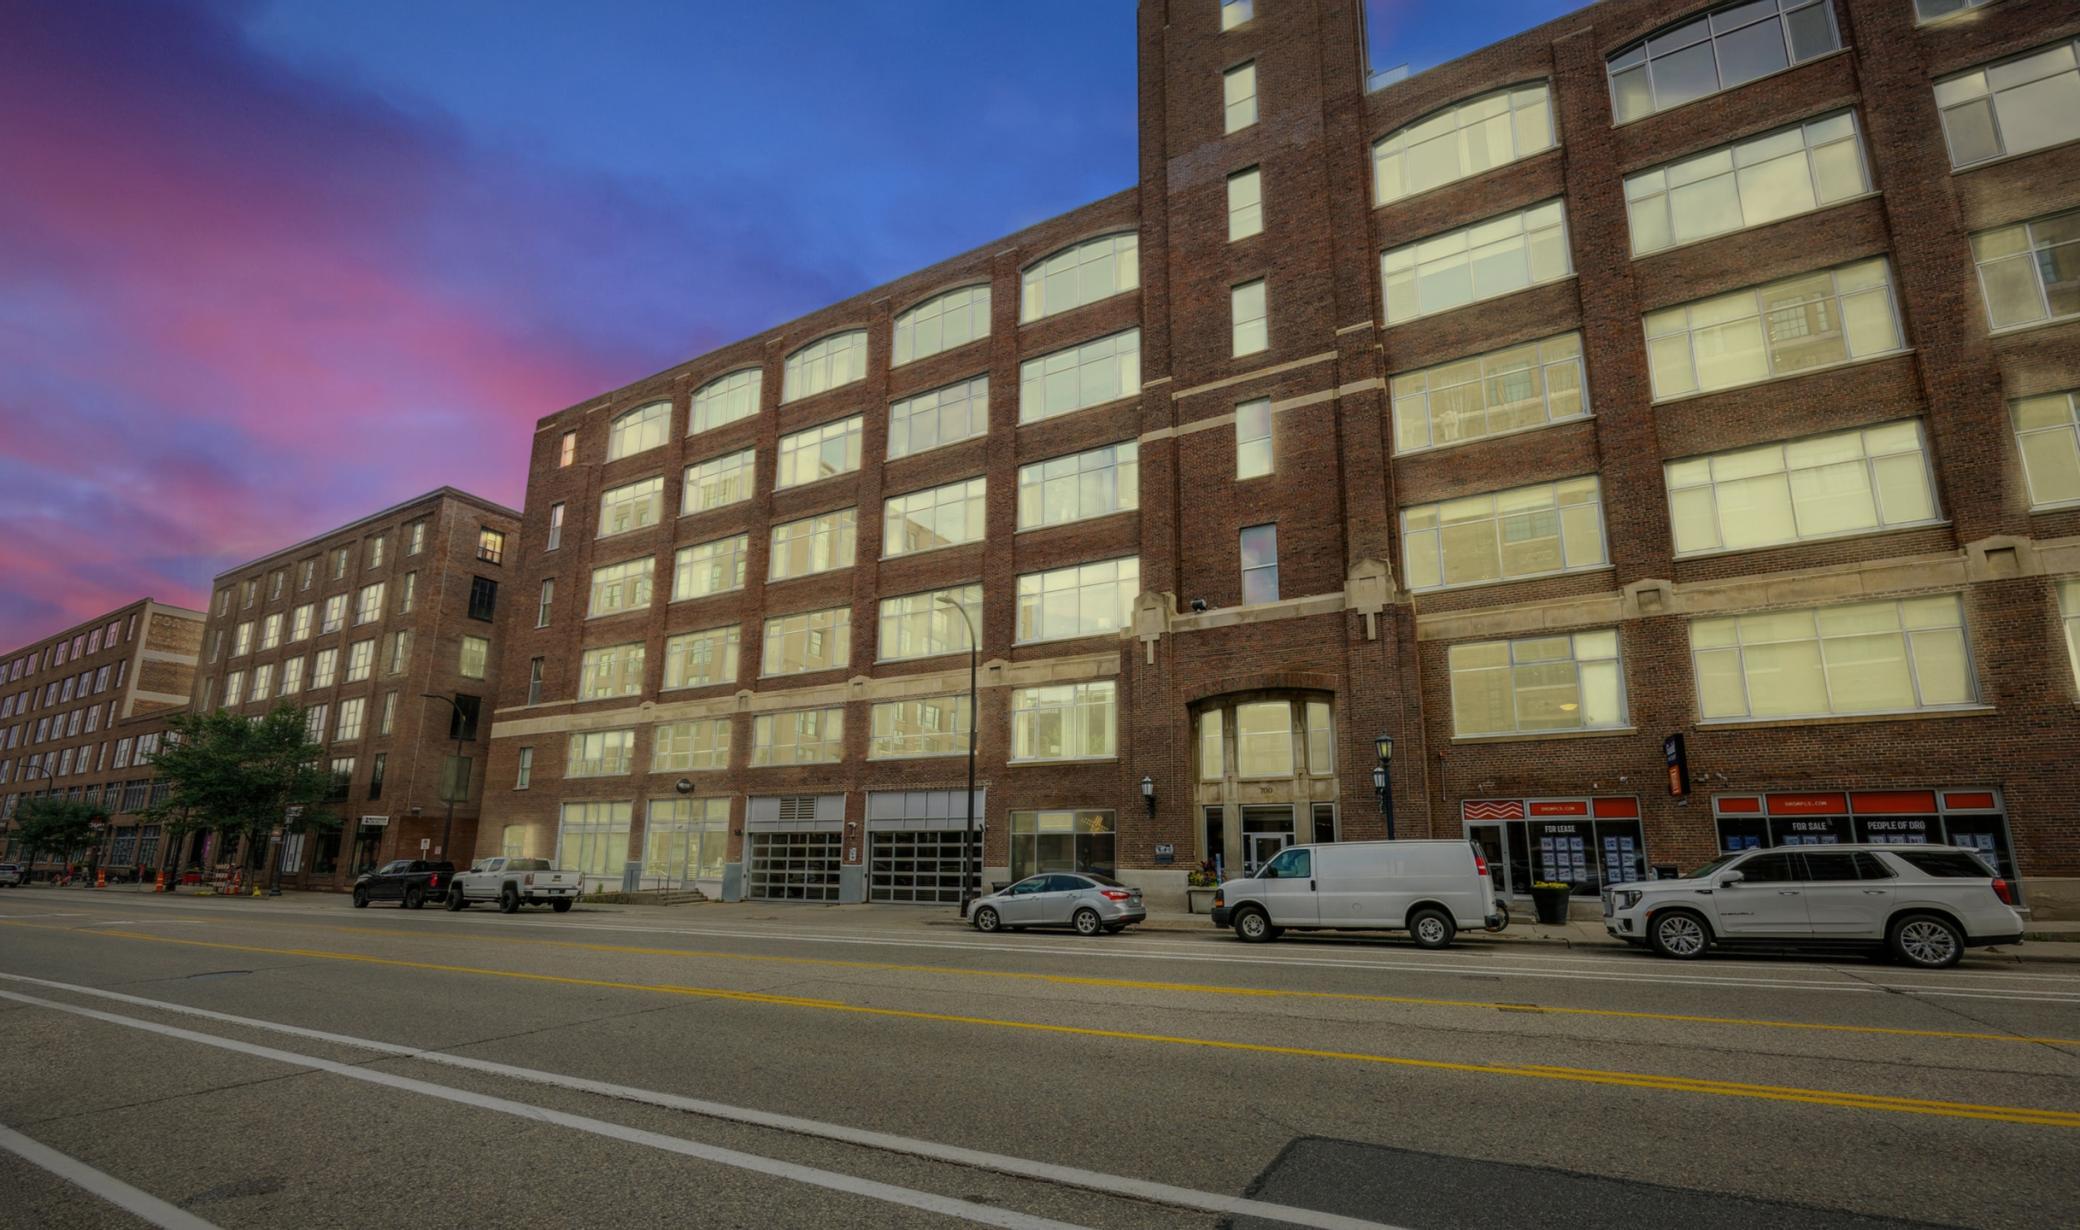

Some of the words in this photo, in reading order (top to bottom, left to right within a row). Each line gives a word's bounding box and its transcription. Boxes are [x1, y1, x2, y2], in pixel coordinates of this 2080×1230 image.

[1544, 825, 1557, 833] FOR
[1557, 825, 1576, 833] LEASE
[1792, 822, 1808, 831] FOR
[1808, 821, 1827, 831] SALE
[1867, 821, 1897, 830] PEOPLE
[1897, 821, 1908, 830] OF
[1909, 821, 1926, 830] DRO
